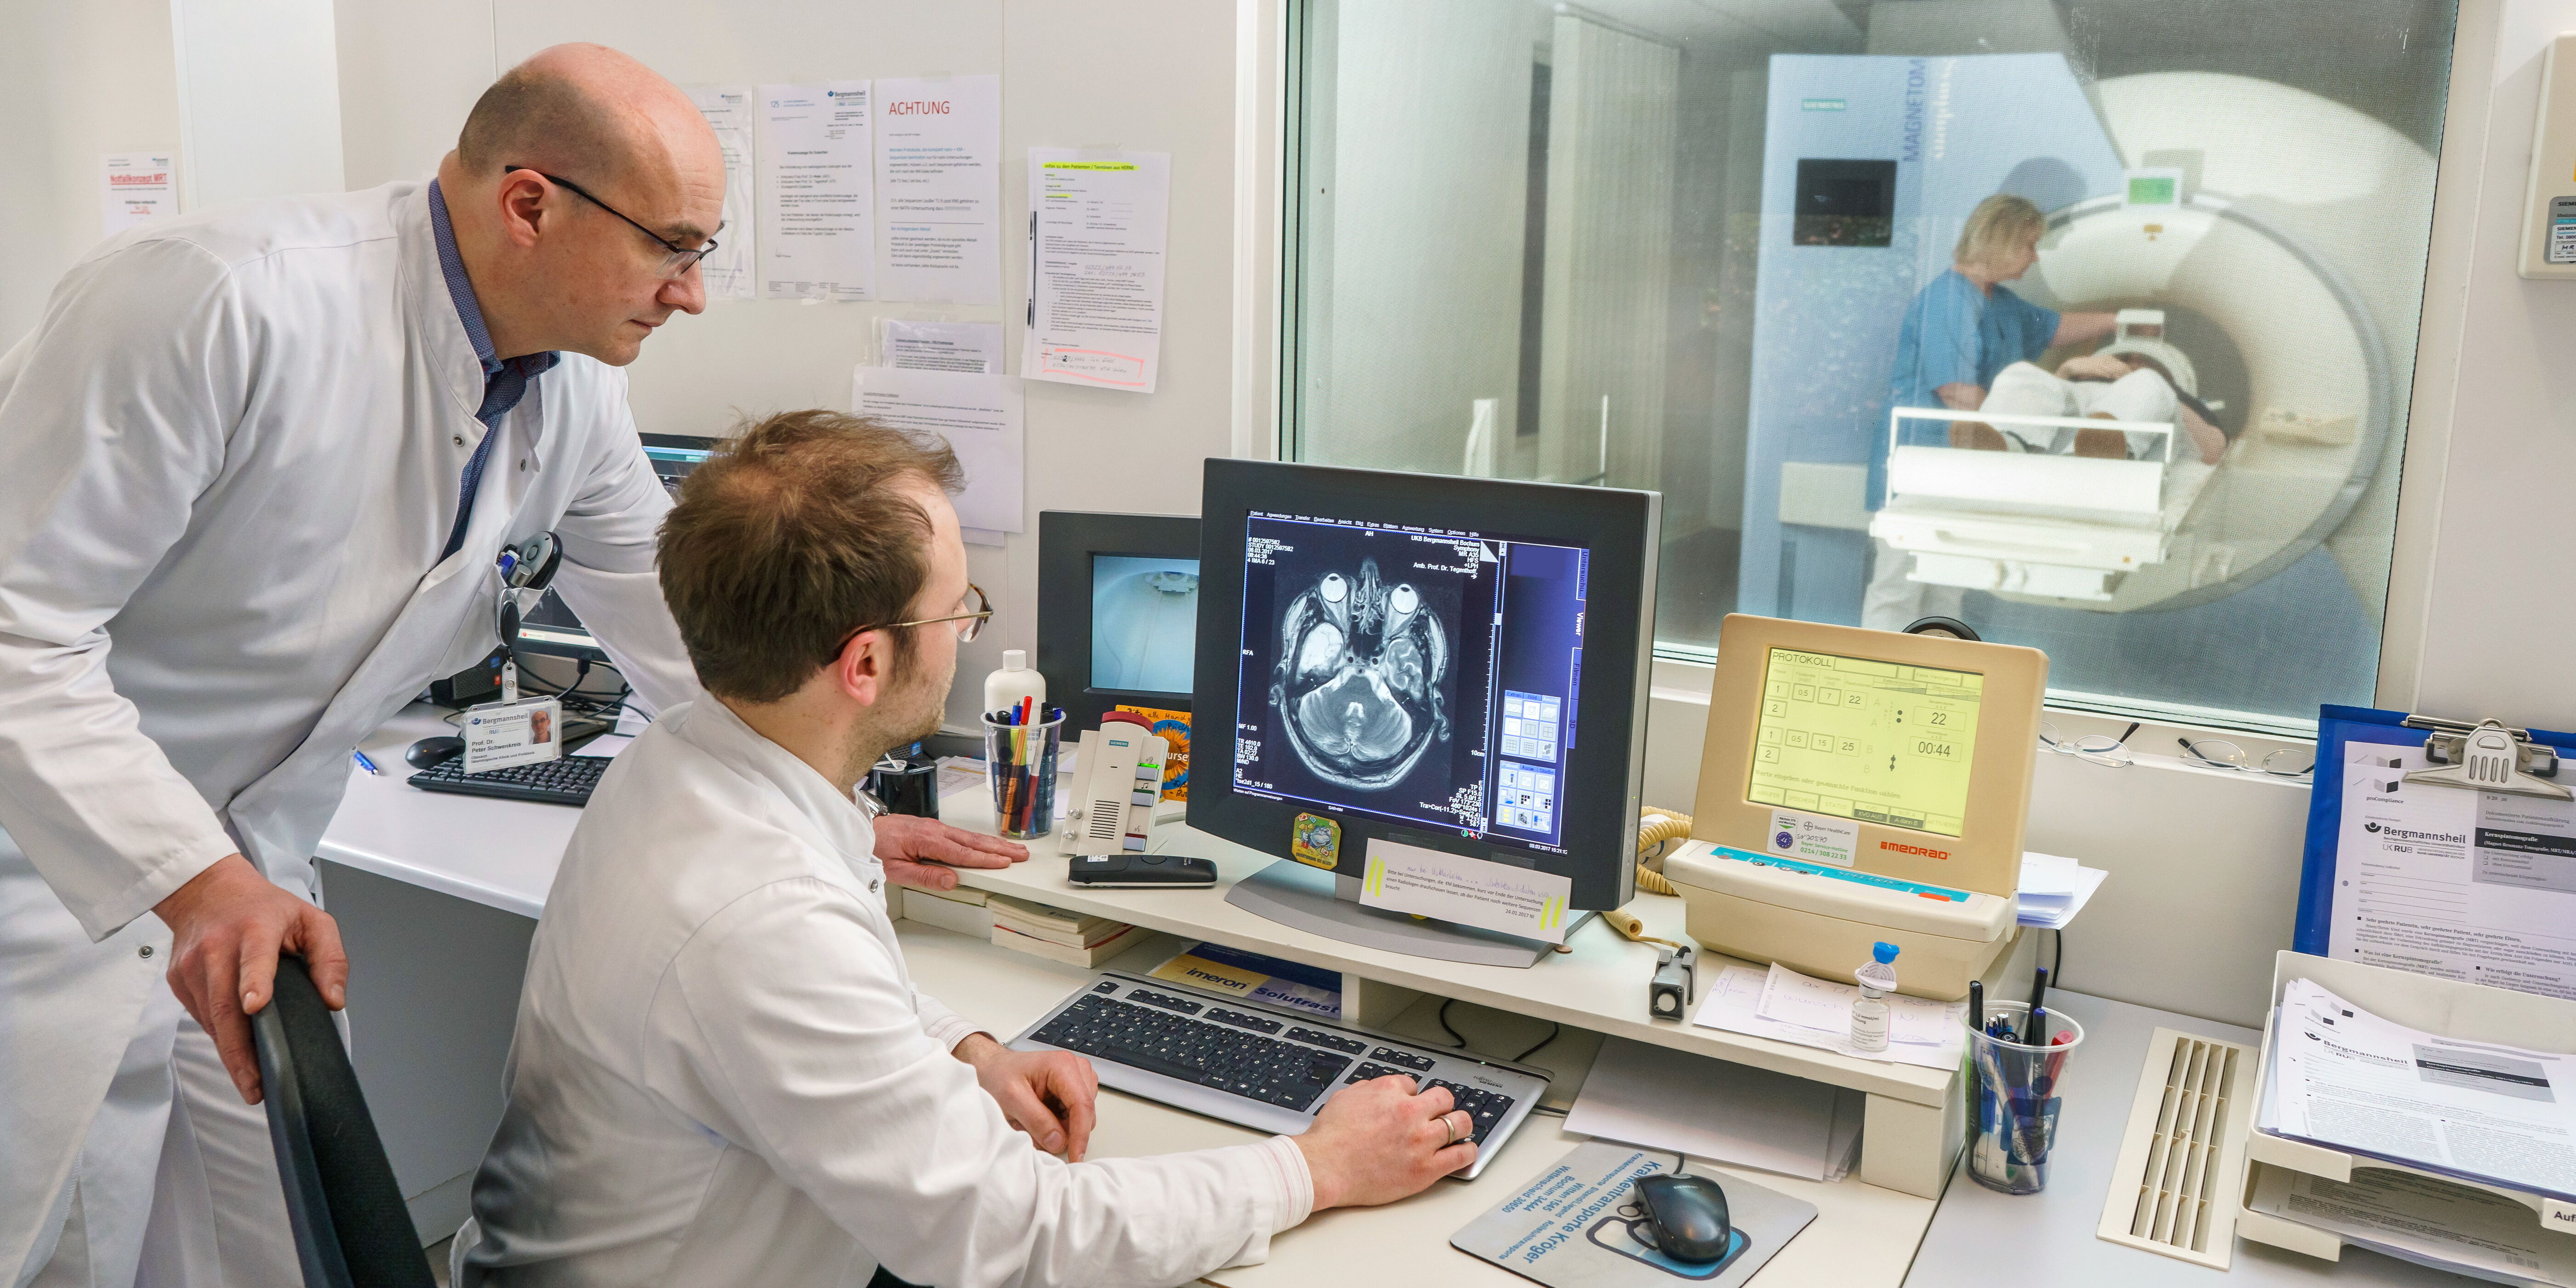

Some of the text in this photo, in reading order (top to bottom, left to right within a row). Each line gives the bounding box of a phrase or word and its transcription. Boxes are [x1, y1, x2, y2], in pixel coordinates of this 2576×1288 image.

[889, 101, 950, 115] ACHTUNG
[1424, 537, 1459, 545] Bergmannsheil
[1575, 612, 1584, 636] Viewer
[1773, 652, 1832, 667] PROTOKOLL
[1572, 663, 1580, 686] Filmen
[1849, 696, 1861, 704] 22
[483, 713, 528, 724] Bergmannsheil
[1569, 719, 1575, 729] 3D
[1931, 713, 1946, 725] 22
[487, 742, 521, 751] Schwenkreis
[1842, 742, 1854, 751] 25
[1918, 742, 1951, 757] 00:44
[2521, 814, 2570, 824] Patientenaufklärung
[2384, 826, 2466, 844] Bergmannsheil
[2484, 832, 2538, 842] Kernspintomografie
[1815, 843, 1848, 853] Service-Hotline
[1398, 879, 1419, 887] Radiologen
[1420, 883, 1445, 893] draufschauen
[1518, 904, 1540, 912] Sequenzen
[1404, 873, 1436, 884] Untersuchungen,
[1453, 883, 1476, 892] bekommen,
[1515, 896, 1543, 906] Untersuchung
[1506, 909, 1528, 918] 24.01.2017
[2393, 954, 2443, 965] Kernspintomografie?
[1185, 968, 1248, 990] imeron
[2522, 972, 2561, 982] Untersuchung?
[1254, 987, 1340, 1013] Solutrast
[2324, 1040, 2408, 1065] Bergmannsheil
[1597, 1152, 1645, 1186] Krankentransporte
[1502, 1165, 1571, 1213] Wattenscheid 30650
[1523, 1175, 1576, 1212] Bochum 34444
[1542, 1183, 1586, 1212] Witten 1545
[1498, 1220, 1555, 1260] Rollstuhltransporte
[1523, 1232, 1570, 1264] Kröger
